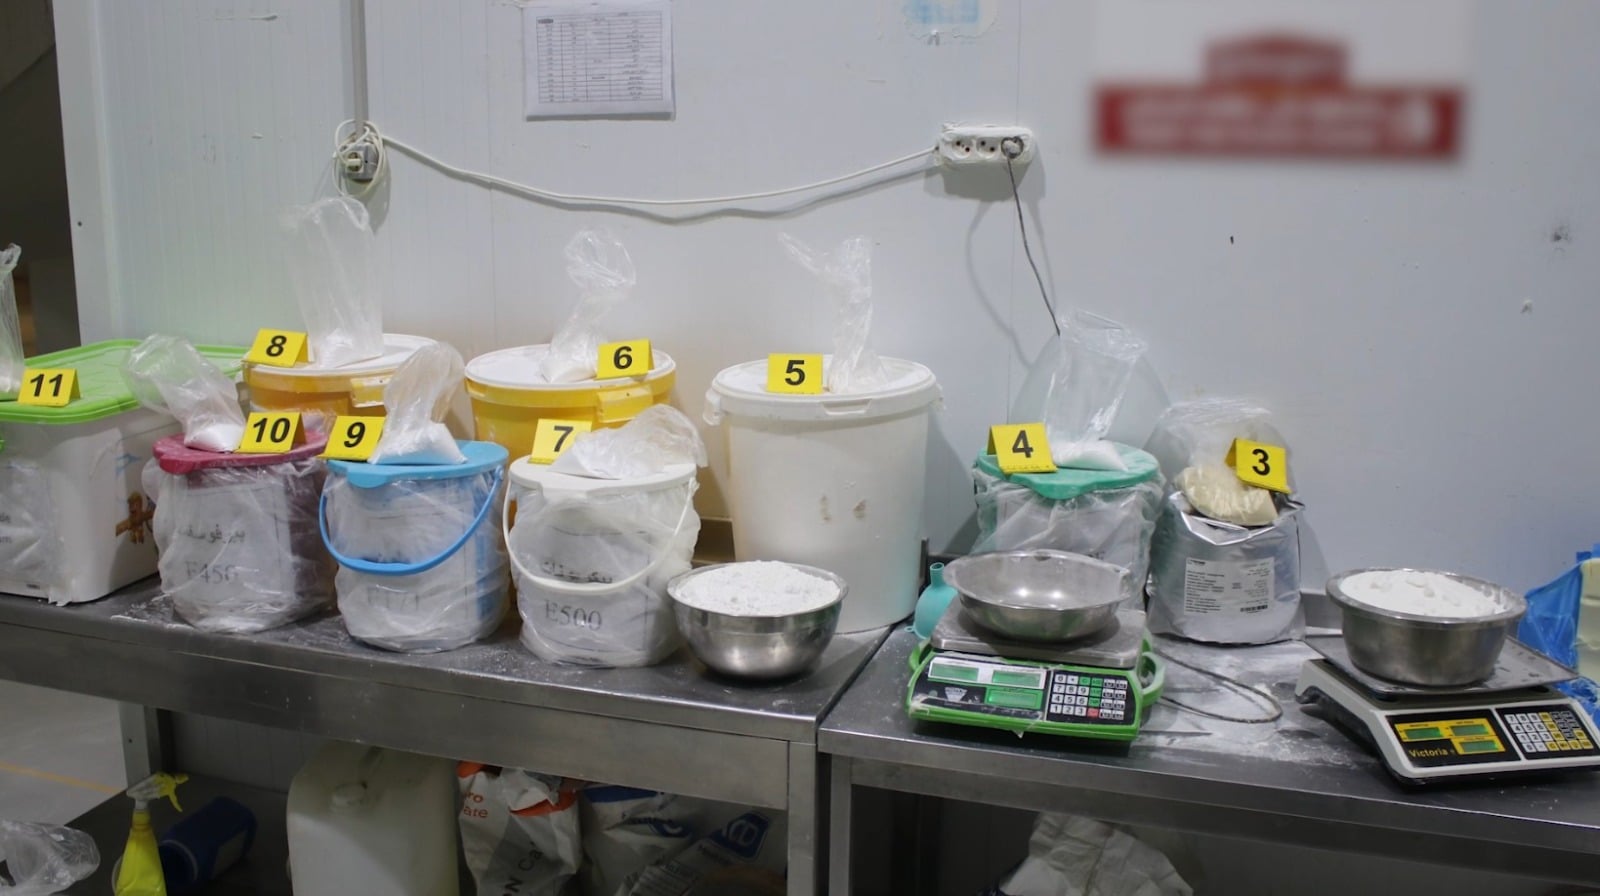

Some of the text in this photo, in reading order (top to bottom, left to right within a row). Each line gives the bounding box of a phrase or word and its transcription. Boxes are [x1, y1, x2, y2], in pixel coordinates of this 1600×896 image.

[266, 335, 287, 357] 8
[613, 346, 633, 370] 6
[30, 373, 63, 397] 11
[785, 359, 805, 386] 5
[253, 417, 291, 443] 10
[343, 421, 366, 448] 9
[554, 425, 574, 452] 7
[1012, 429, 1034, 458] 4
[1252, 448, 1271, 476] 3
[544, 599, 603, 631] E500
[1409, 747, 1448, 757] Victoria
